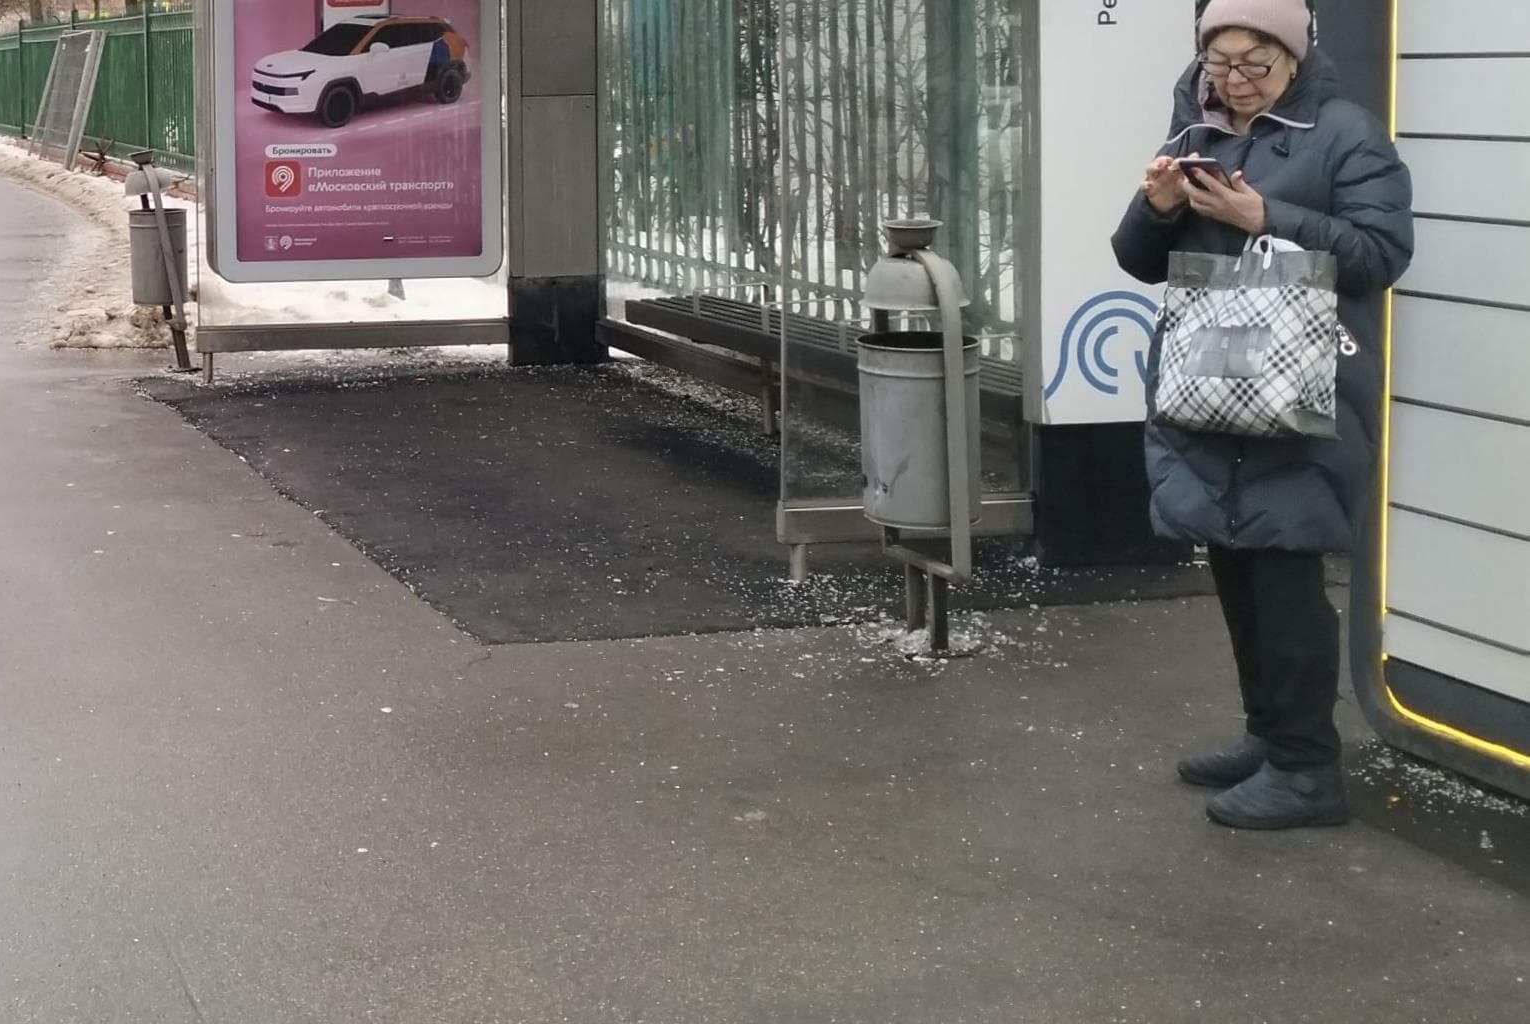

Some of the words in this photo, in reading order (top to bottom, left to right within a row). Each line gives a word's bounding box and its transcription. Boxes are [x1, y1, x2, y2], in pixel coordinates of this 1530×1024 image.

[272, 146, 333, 156] Бронировать
[308, 166, 382, 179] Приложение
[308, 181, 387, 193] «Московский
[389, 180, 455, 192] транспорт»
